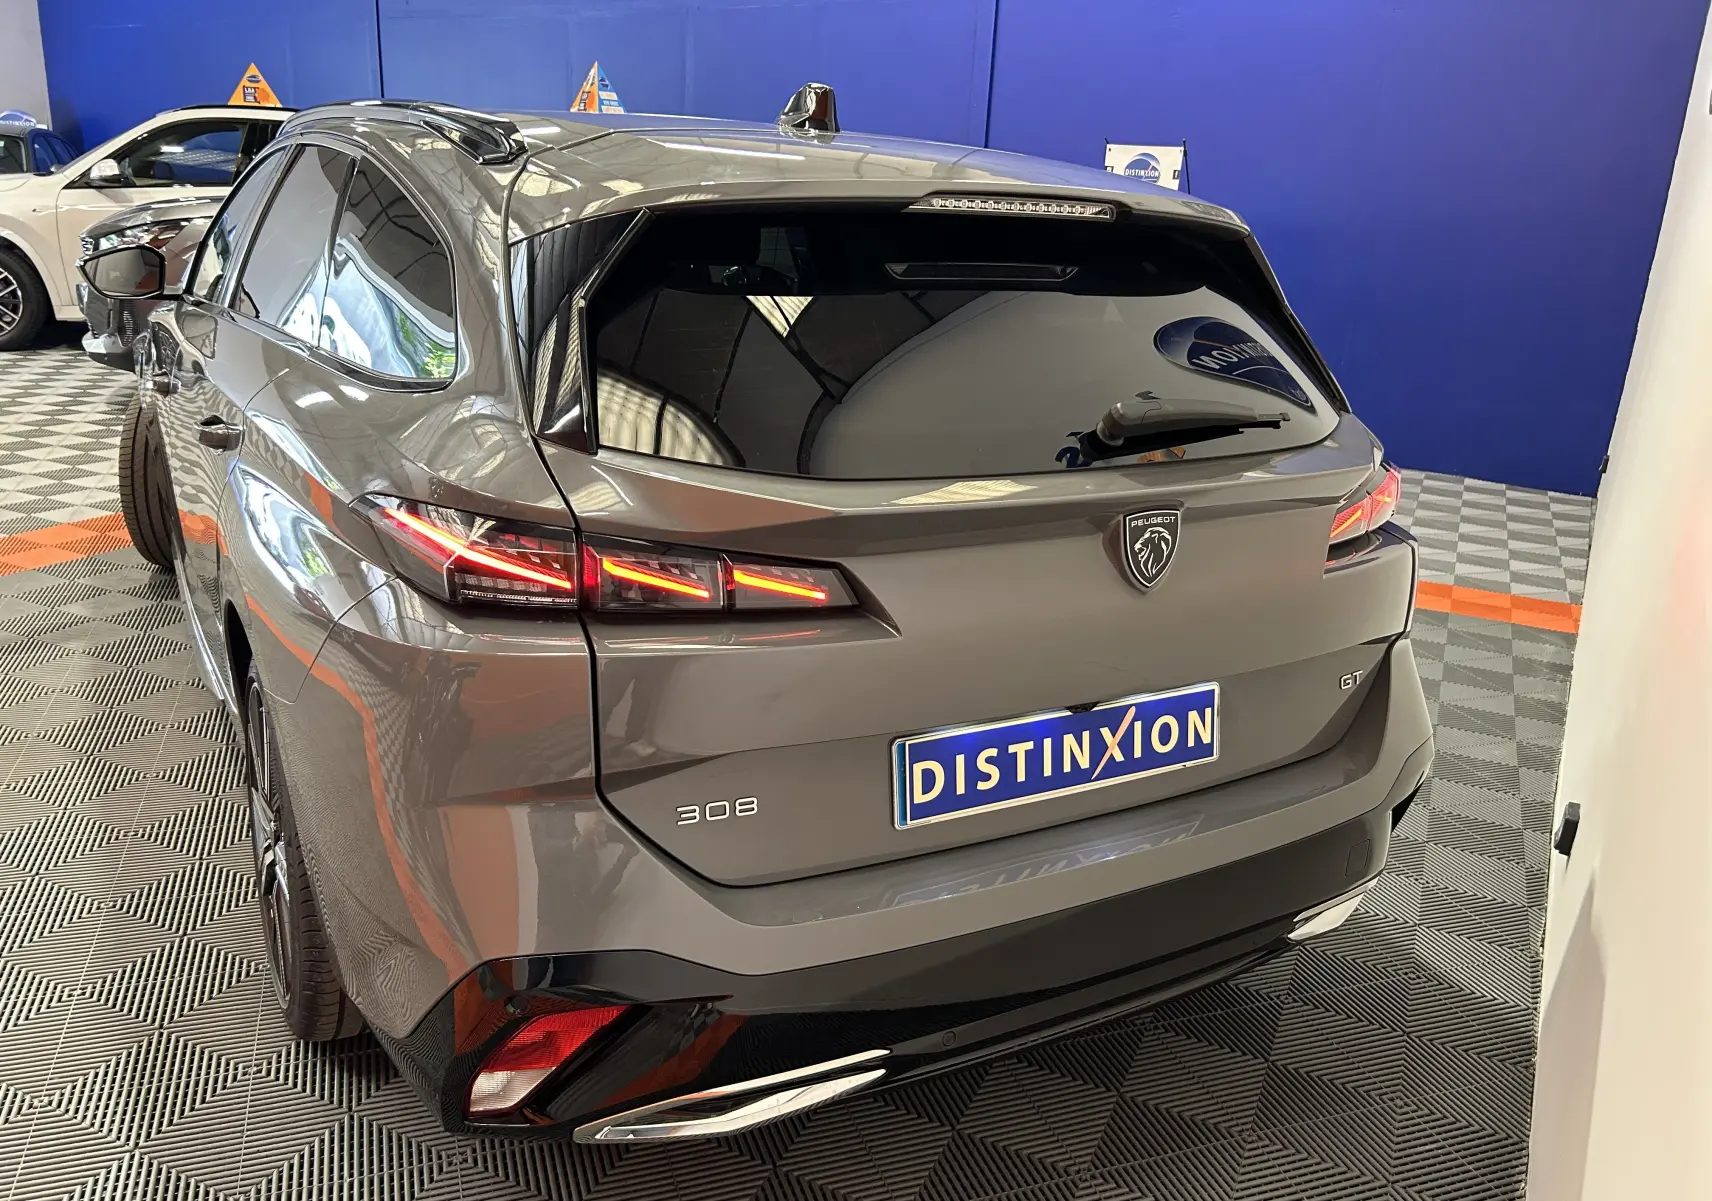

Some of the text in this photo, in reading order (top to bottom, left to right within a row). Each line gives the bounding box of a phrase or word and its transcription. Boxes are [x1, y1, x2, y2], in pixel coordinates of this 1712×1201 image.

[1125, 168, 1159, 178] DISTINXION
[1131, 516, 1175, 527] PEUGEOT
[1340, 670, 1363, 689] GT
[912, 705, 1212, 804] DISTINXION
[676, 797, 758, 825] 308
